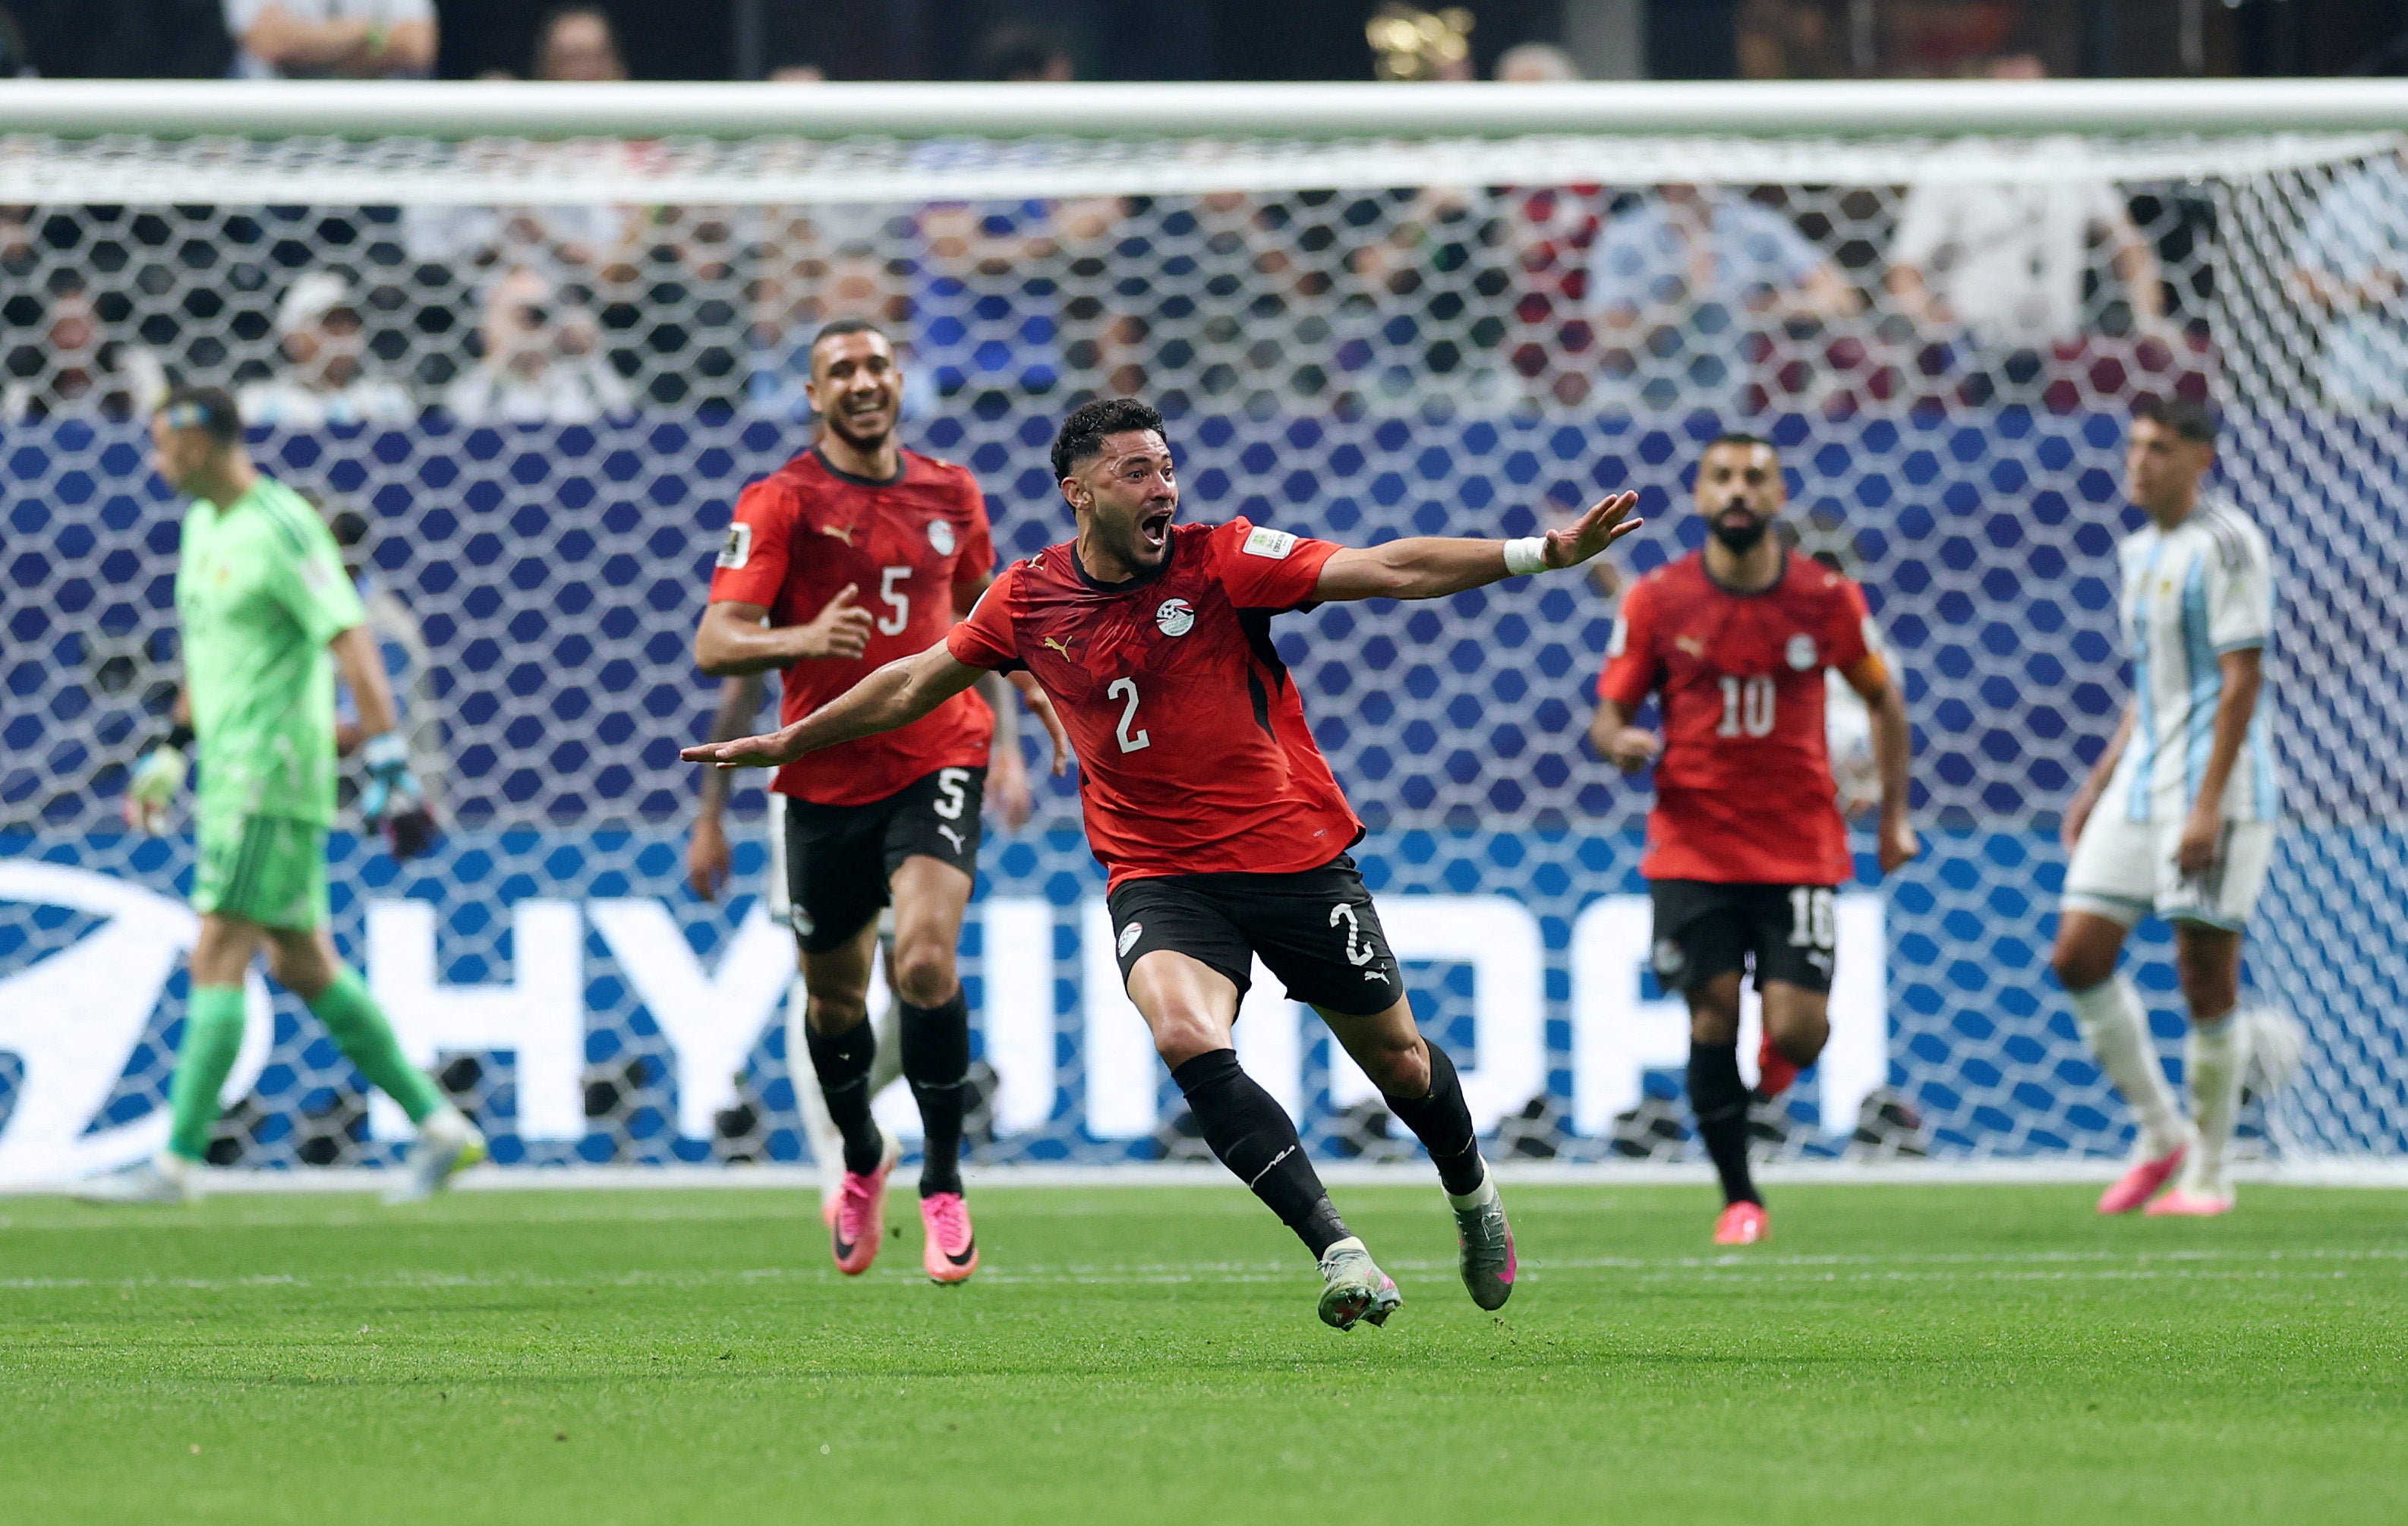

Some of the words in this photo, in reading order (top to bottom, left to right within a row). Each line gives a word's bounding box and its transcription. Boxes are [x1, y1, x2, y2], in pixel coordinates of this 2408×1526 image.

[877, 566, 913, 636] 5
[1107, 676, 1151, 754] 2
[1715, 674, 1778, 739] 10
[933, 767, 971, 820] 5
[1329, 902, 1375, 966] 2
